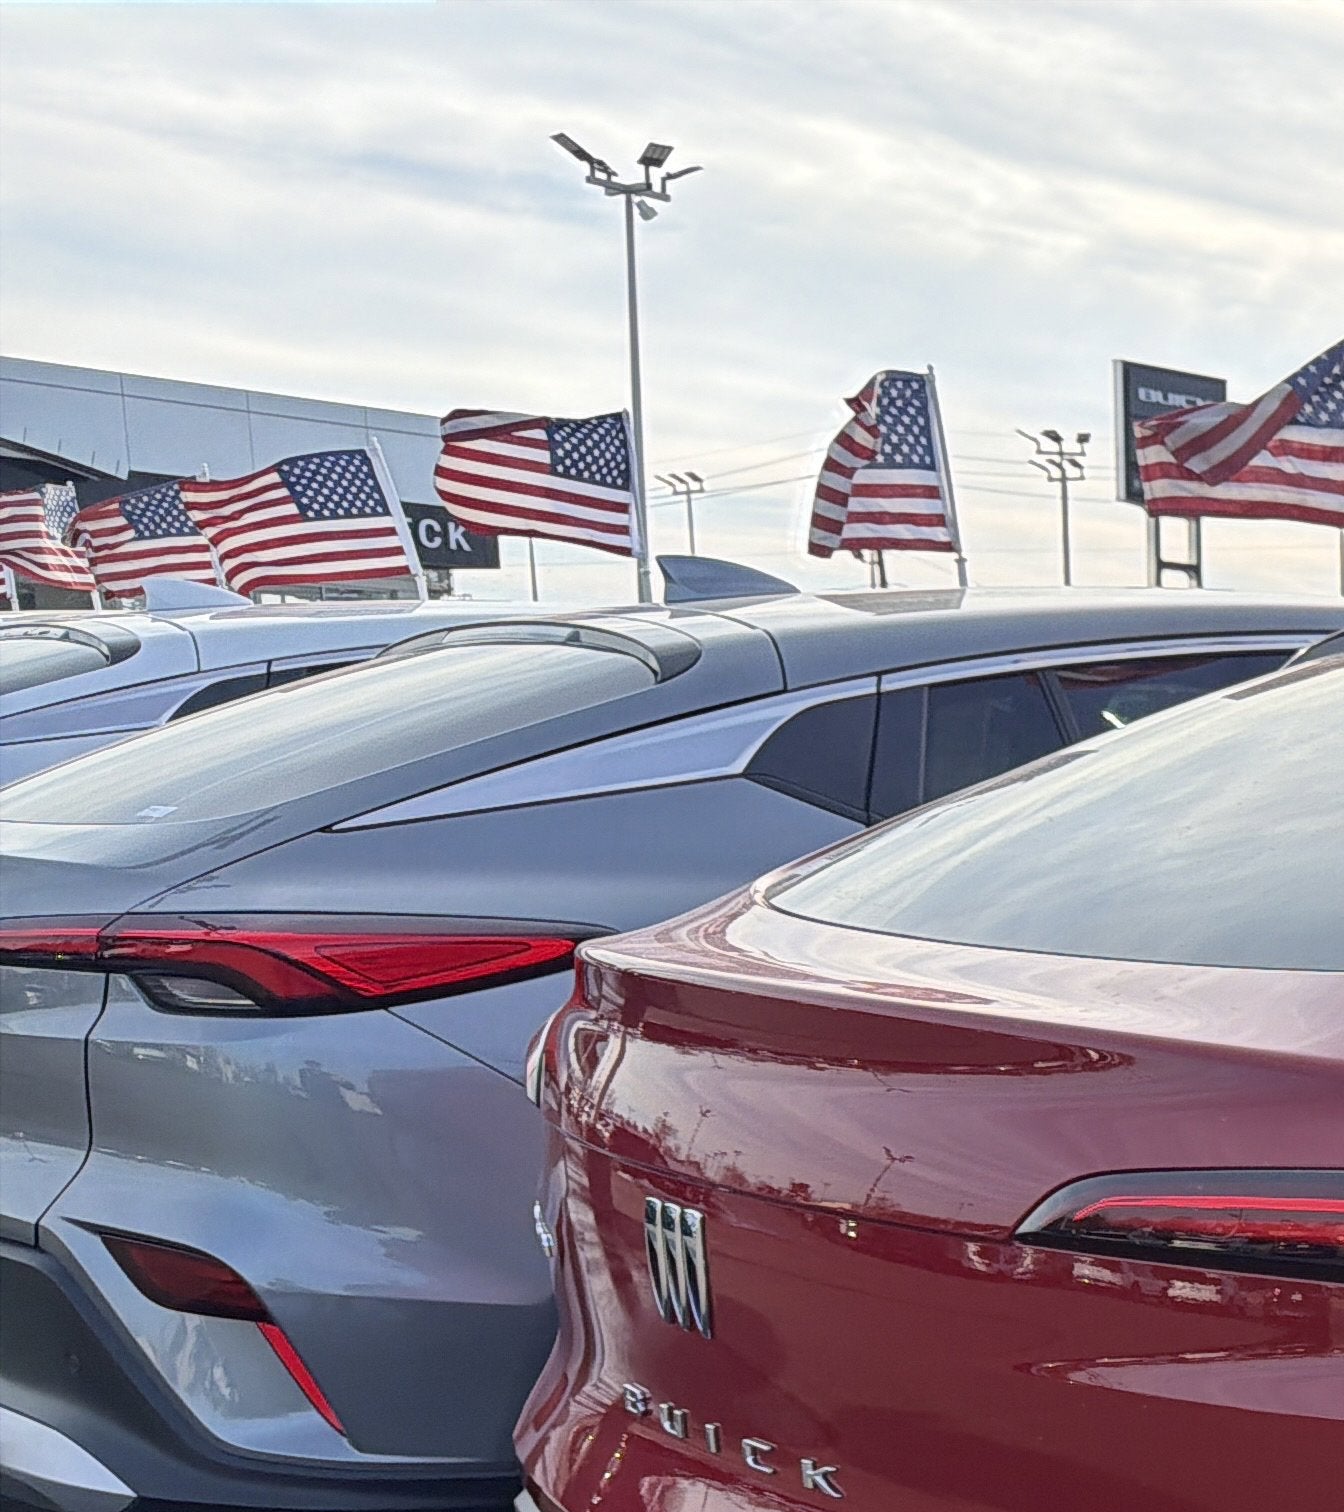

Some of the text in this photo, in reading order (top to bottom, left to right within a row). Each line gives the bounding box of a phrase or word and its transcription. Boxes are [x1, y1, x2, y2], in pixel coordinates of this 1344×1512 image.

[1137, 386, 1205, 411] BUIC
[407, 516, 473, 552] CK
[622, 1382, 844, 1499] BUICK
